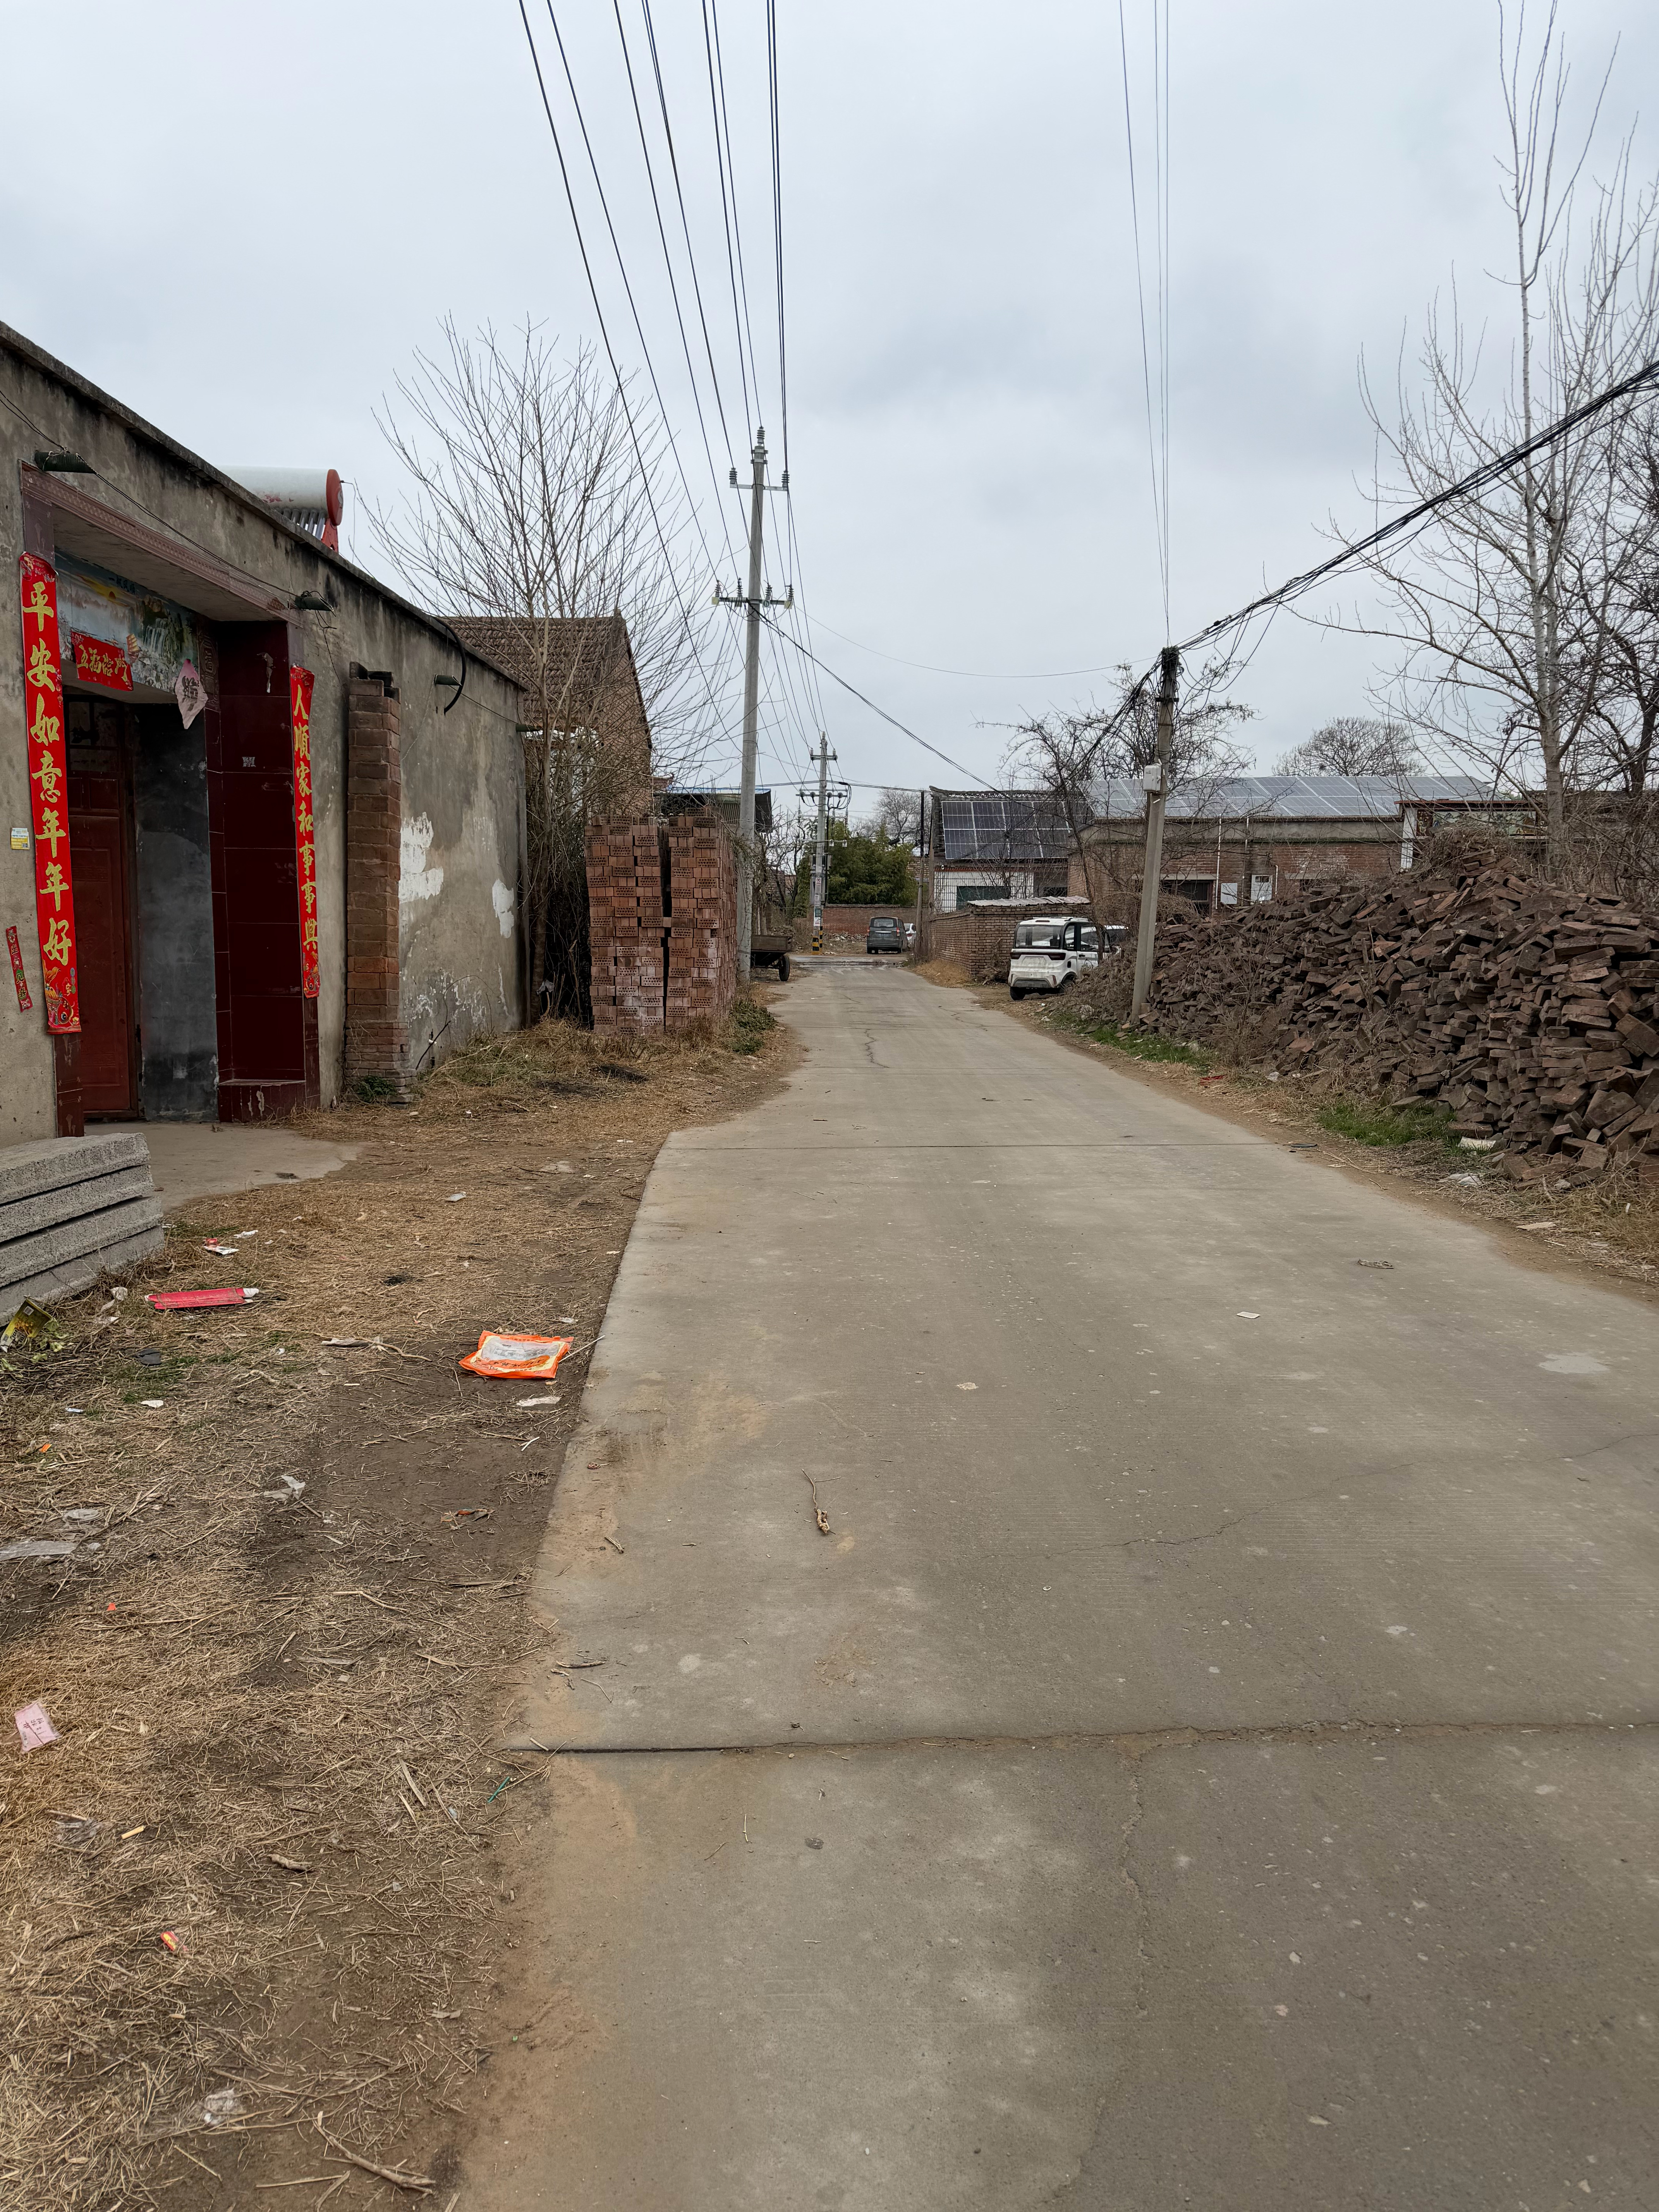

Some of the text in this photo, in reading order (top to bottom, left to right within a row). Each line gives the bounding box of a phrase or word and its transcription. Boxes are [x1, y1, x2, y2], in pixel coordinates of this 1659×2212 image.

[22, 581, 72, 965] 平安如意年年好
